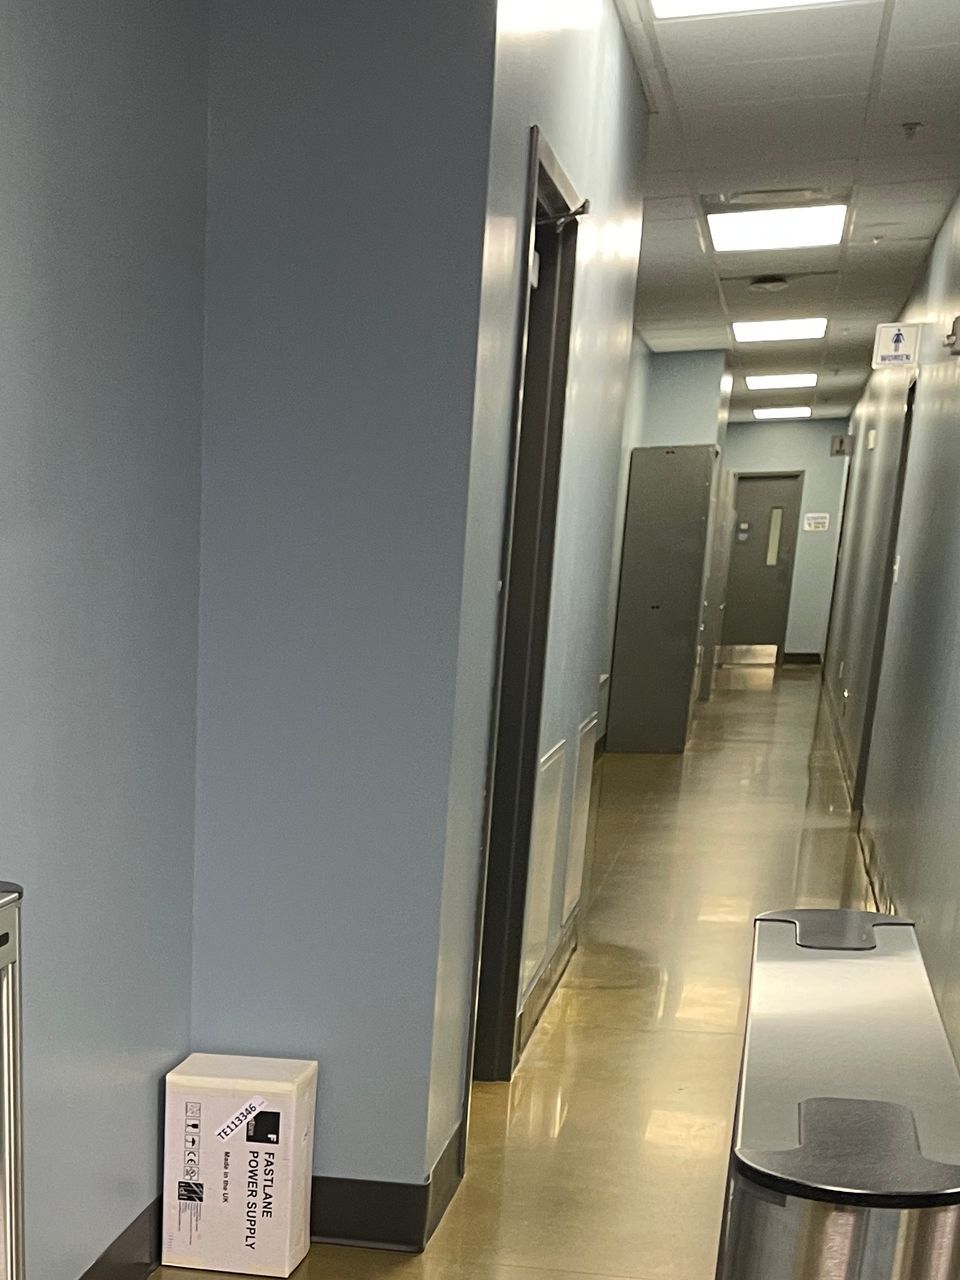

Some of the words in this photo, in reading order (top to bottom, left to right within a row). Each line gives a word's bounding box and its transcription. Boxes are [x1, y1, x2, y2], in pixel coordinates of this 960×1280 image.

[216, 1103, 257, 1141] TE113346
[223, 1151, 231, 1171] Made
[246, 1150, 259, 1198] POWER
[222, 1179, 230, 1192] the
[222, 1193, 229, 1204] UK
[261, 1151, 275, 1218] FASTLANE
[245, 1201, 257, 1250] SUPPLY
